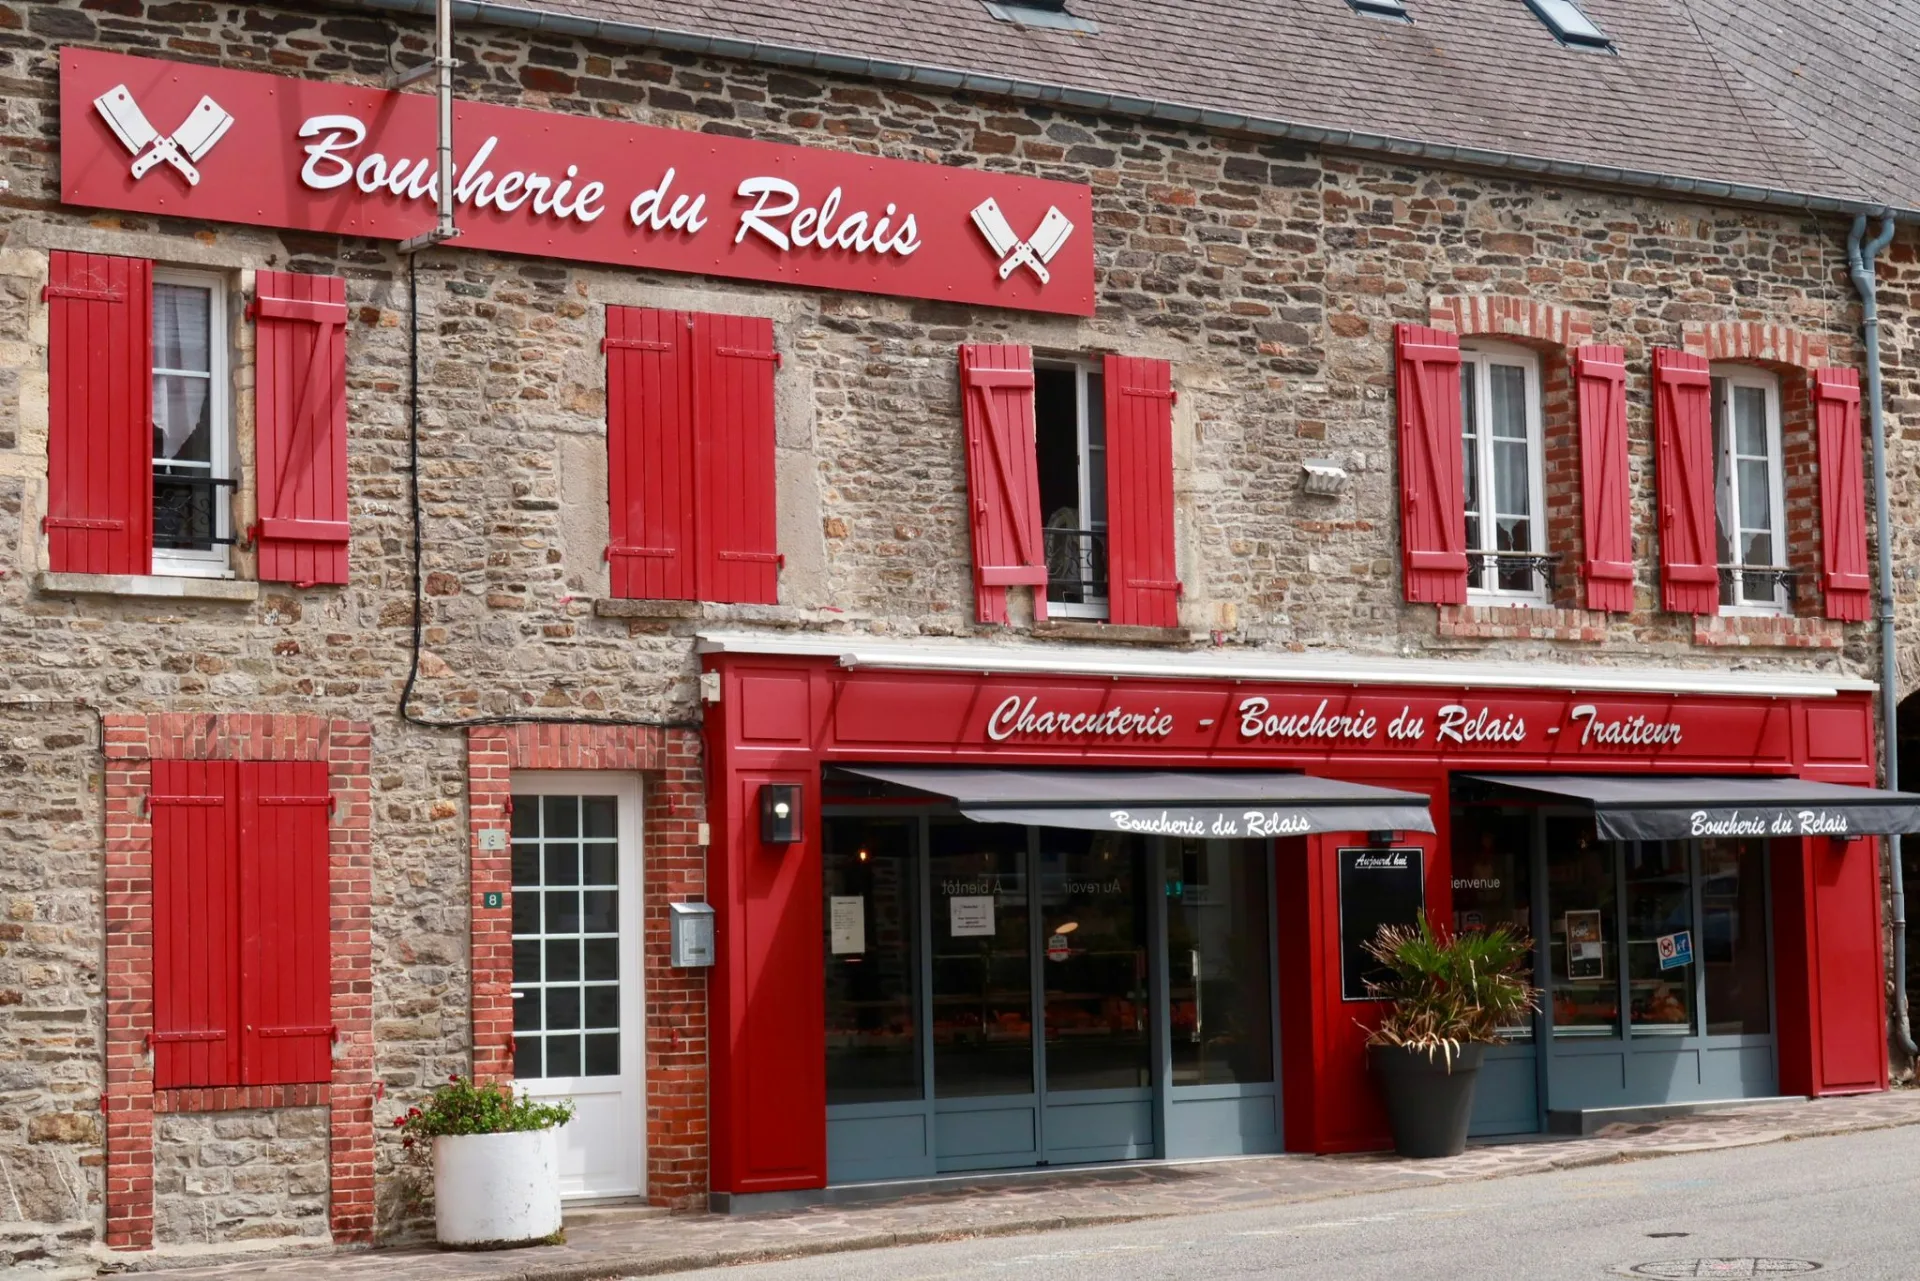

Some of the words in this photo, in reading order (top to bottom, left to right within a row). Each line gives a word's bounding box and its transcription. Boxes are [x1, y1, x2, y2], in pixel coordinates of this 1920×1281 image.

[298, 114, 605, 223] Boucherie
[630, 167, 708, 232] du
[735, 176, 922, 256] Relais
[987, 695, 1173, 740] Charcuterie
[1239, 697, 1377, 739] Boucherie
[1388, 706, 1425, 740] du
[1436, 704, 1527, 744] Relais
[1571, 704, 1682, 745] Traiteur
[1109, 811, 1206, 835] Boucherie
[1211, 813, 1238, 836] du
[1243, 811, 1311, 837] Relais
[1690, 810, 1766, 836] Boucherie
[1771, 812, 1794, 835] du
[1797, 810, 1848, 835] Relais
[1450, 874, 1501, 889] ienvenue
[489, 894, 497, 906] 8
